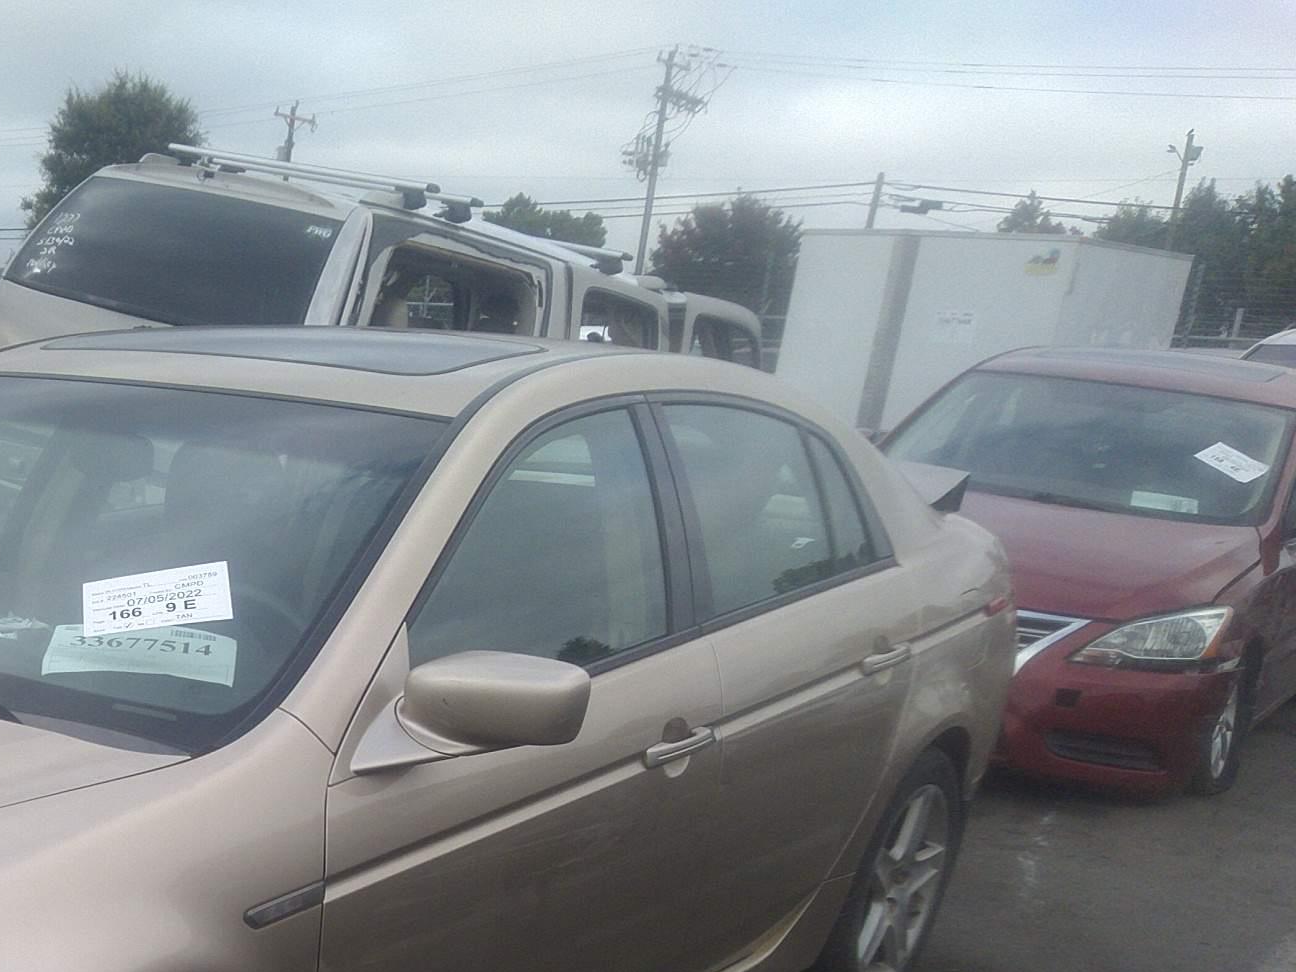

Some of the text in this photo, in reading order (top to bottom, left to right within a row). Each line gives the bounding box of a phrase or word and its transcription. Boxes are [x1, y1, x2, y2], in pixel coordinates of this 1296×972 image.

[127, 588, 203, 606] 07/05/2022
[108, 607, 142, 621] 166
[165, 602, 177, 613] 9
[184, 599, 197, 610] E
[70, 635, 212, 656] 33677514
